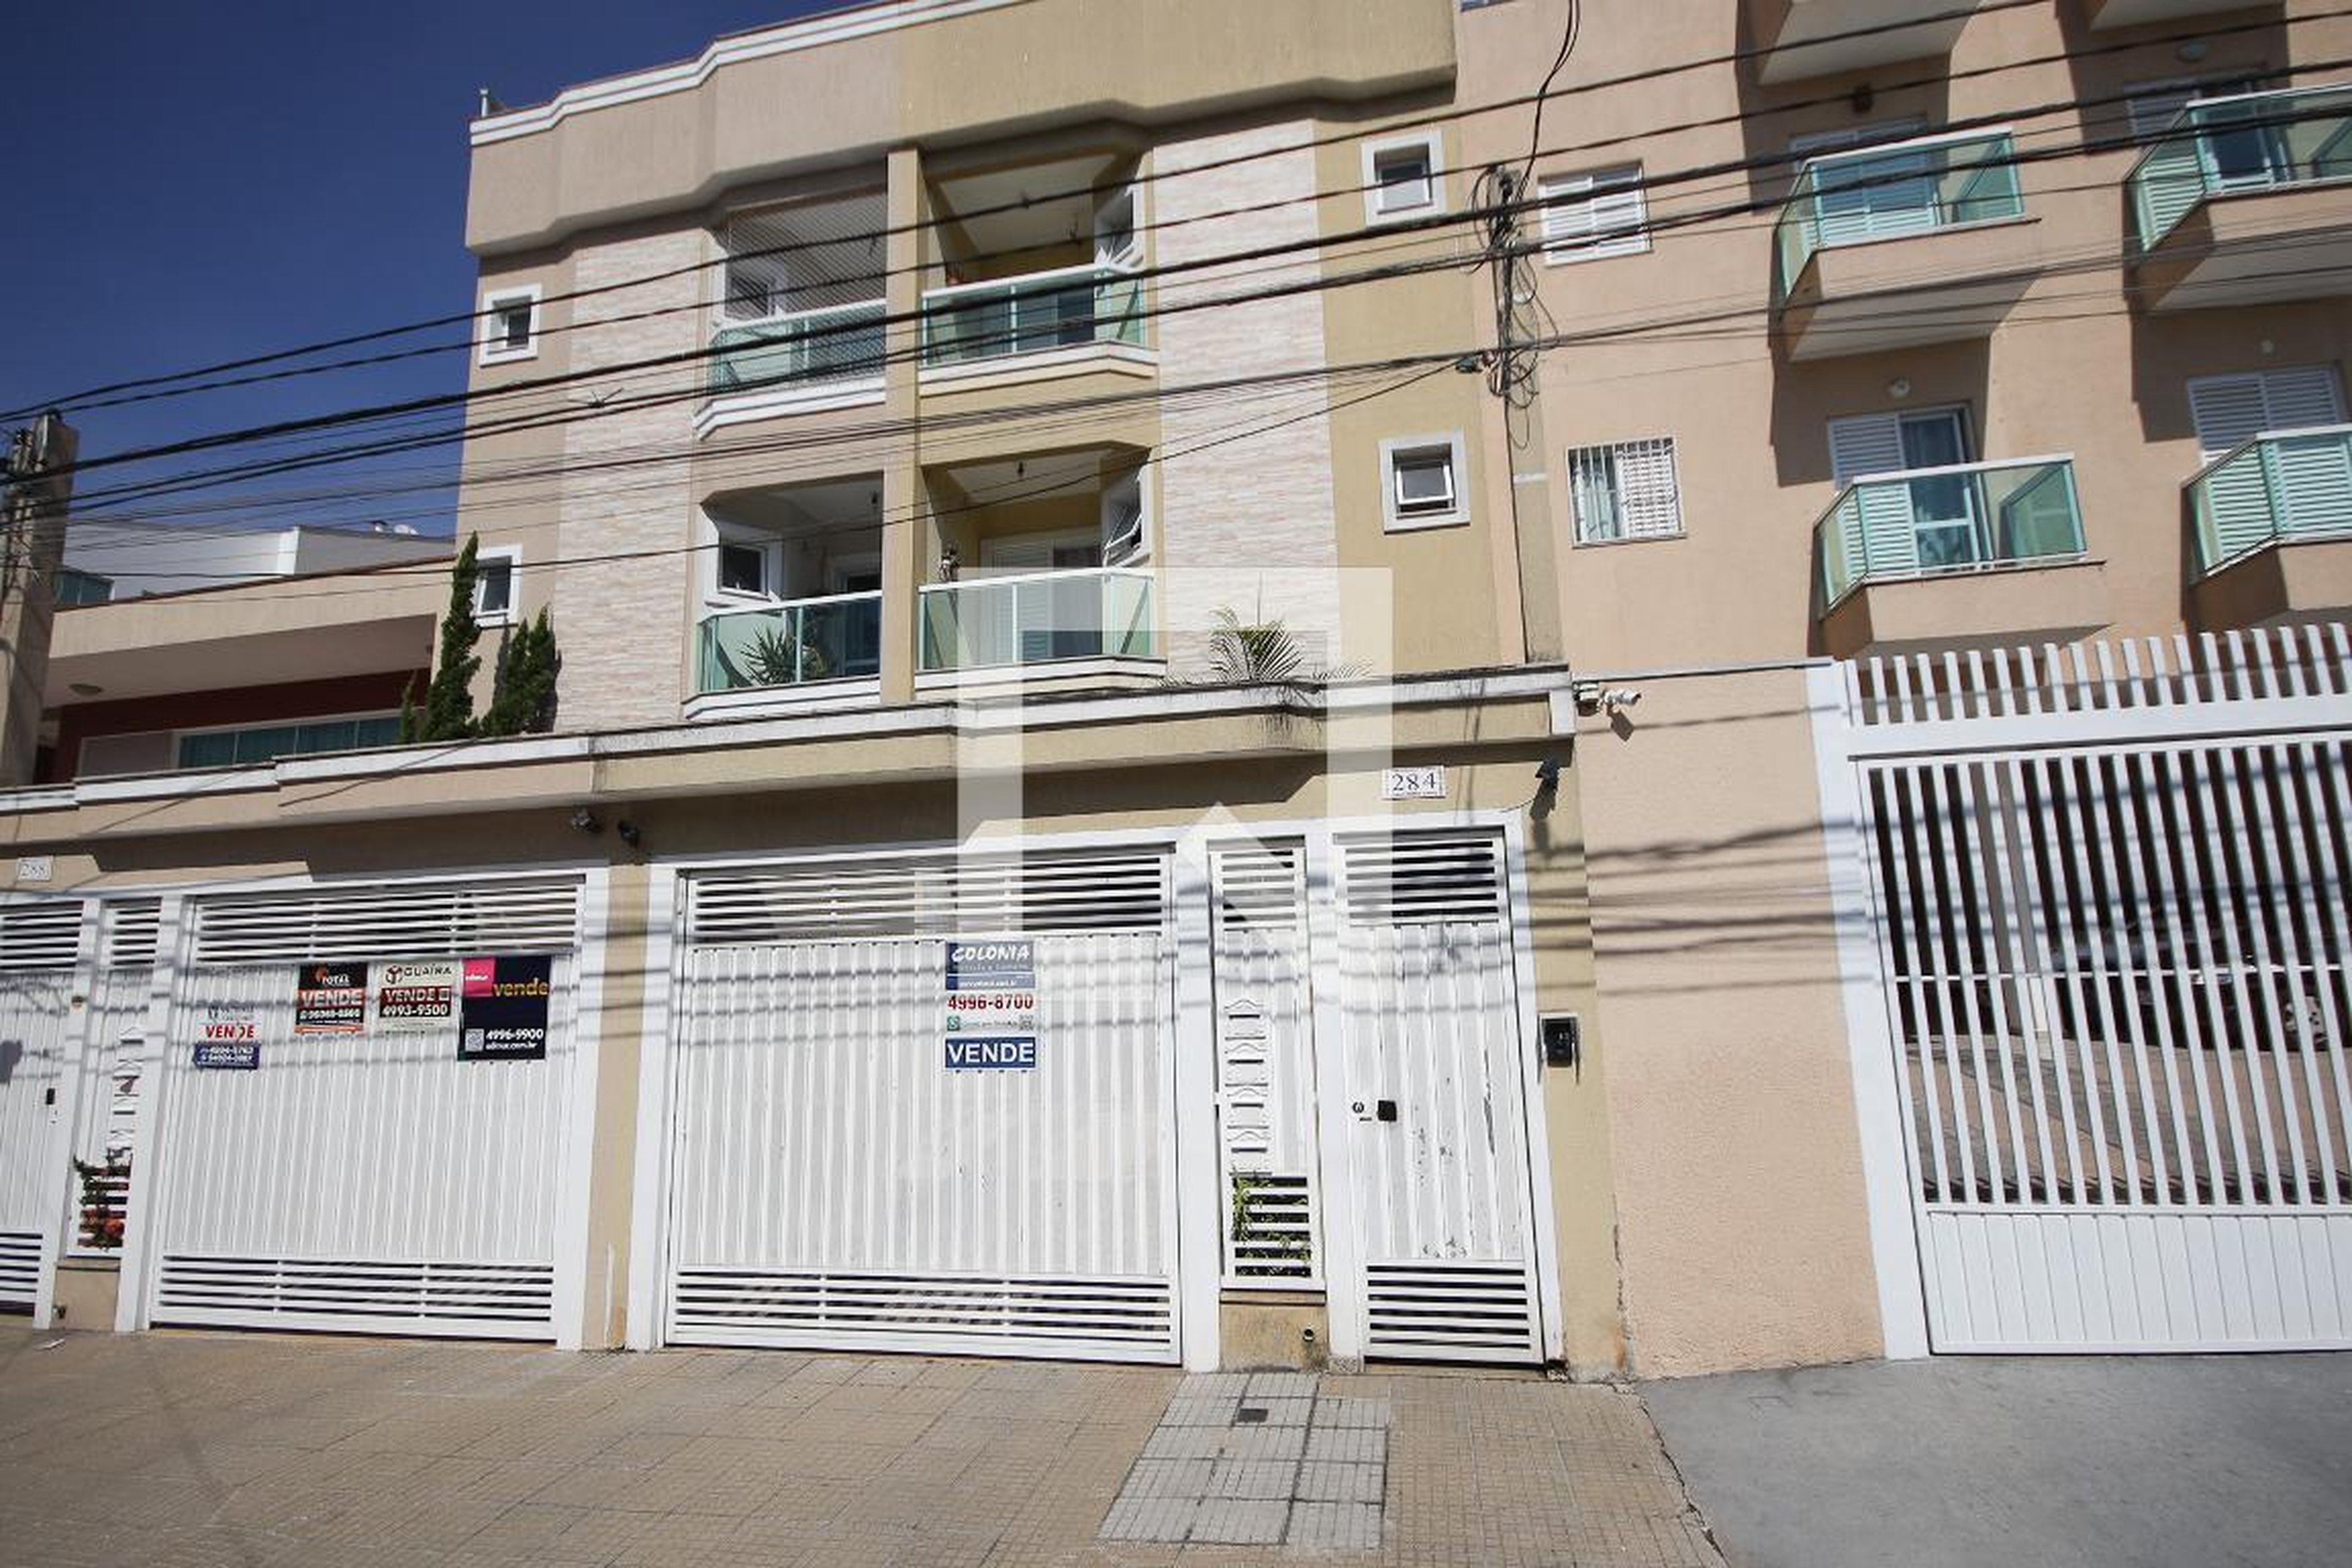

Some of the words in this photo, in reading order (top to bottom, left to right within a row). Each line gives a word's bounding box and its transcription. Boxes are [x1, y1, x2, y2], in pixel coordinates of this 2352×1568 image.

[1391, 772, 1436, 791] 284
[951, 945, 1030, 962] COLONIA
[385, 988, 435, 1002] VENDE
[493, 978, 548, 997] vende
[301, 990, 363, 1006] VENDE
[948, 993, 1034, 1010] 4996-8700
[382, 1005, 448, 1016] 4993-9500
[486, 1028, 544, 1039] 4996-9900
[948, 1043, 1034, 1063] VENDE
